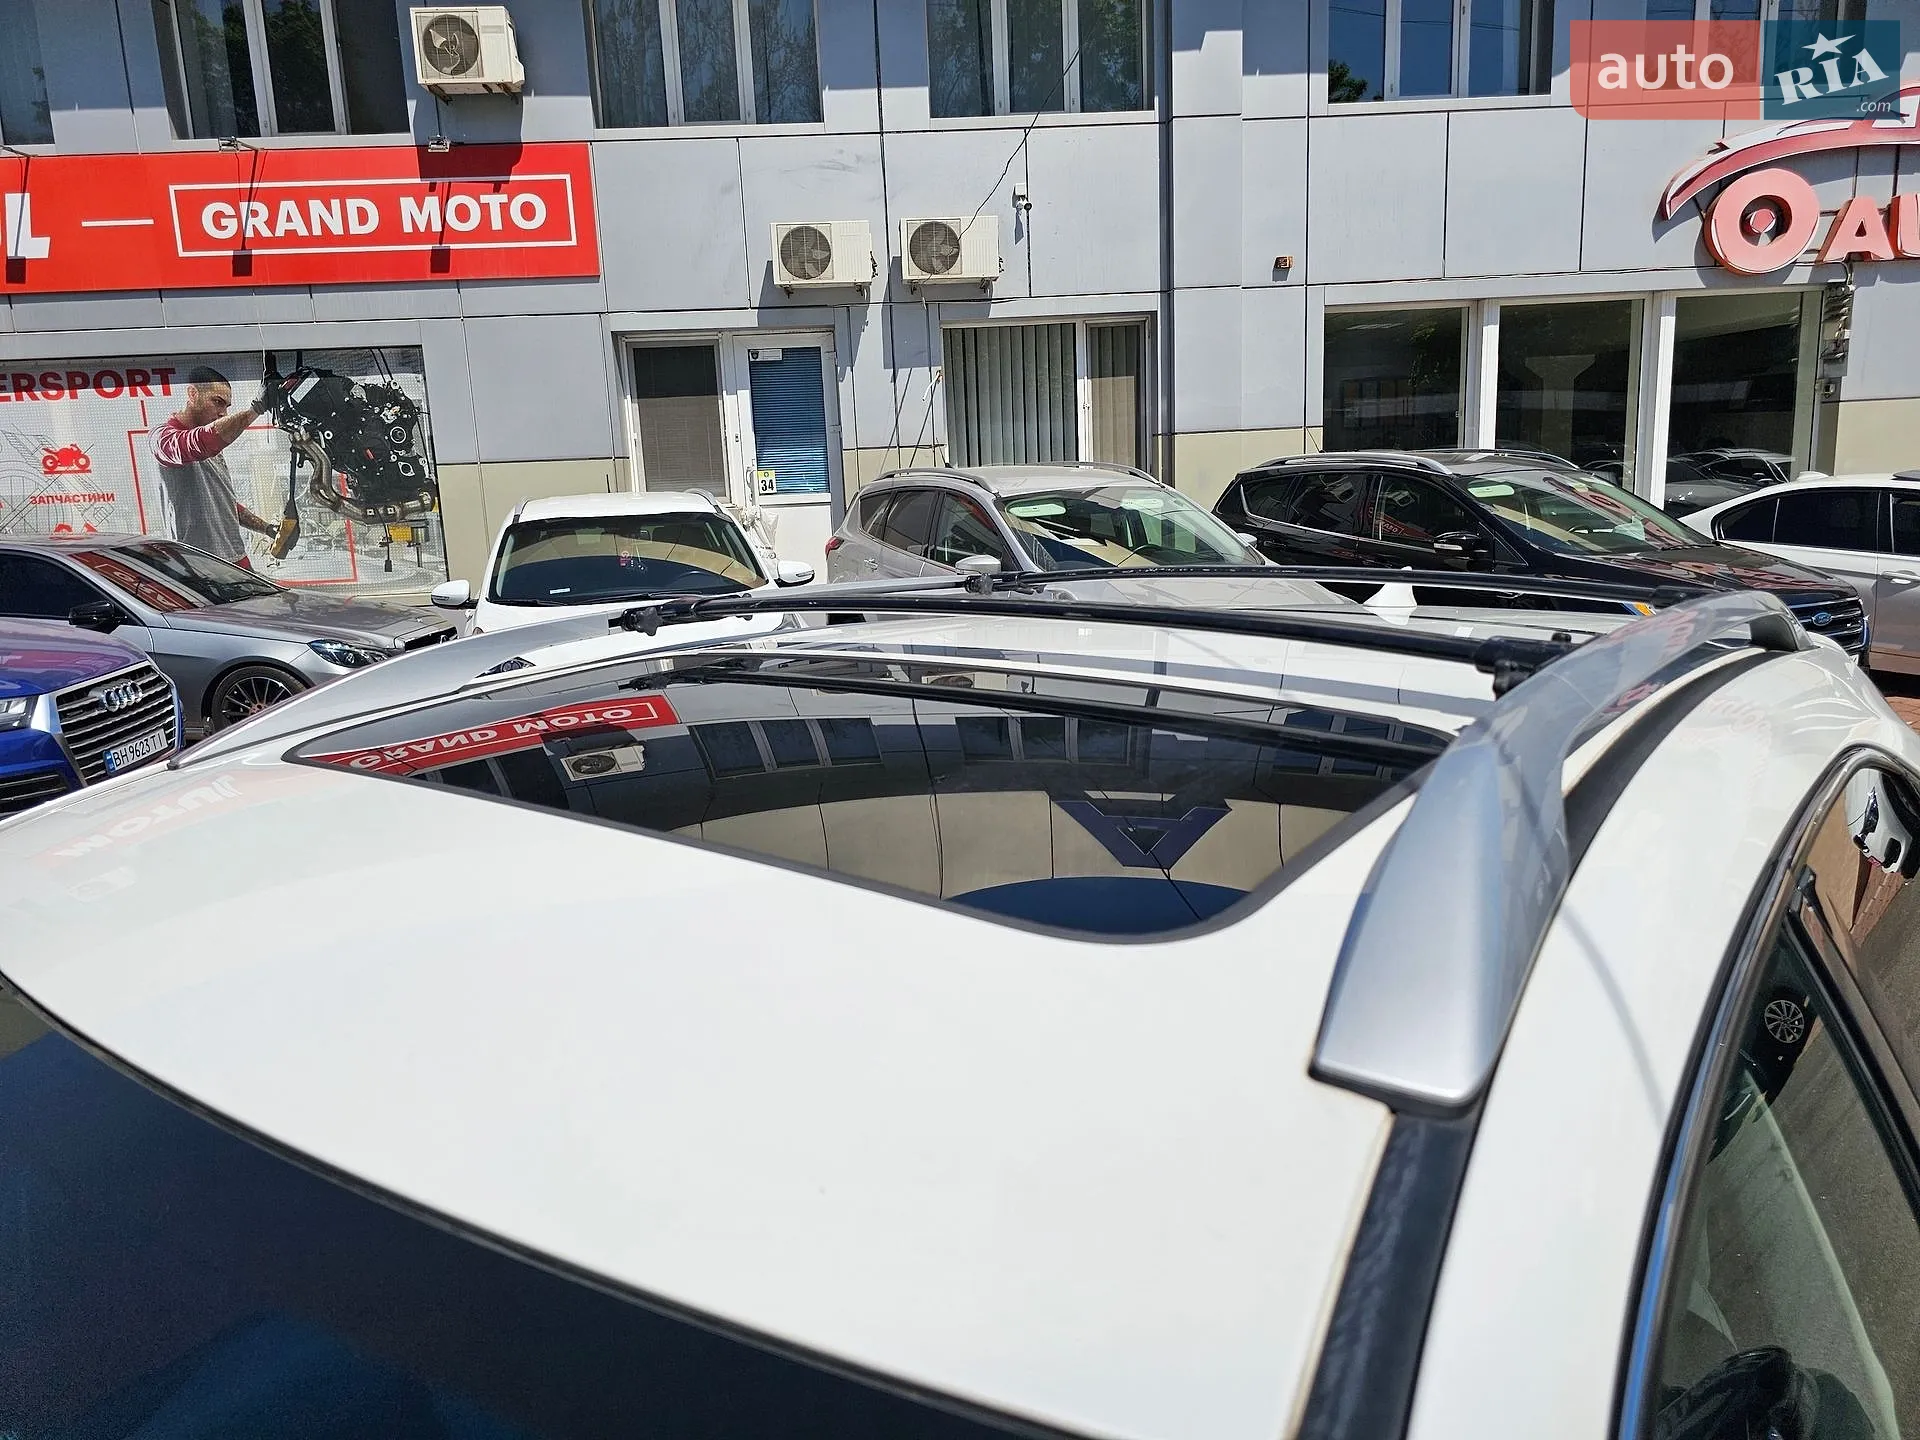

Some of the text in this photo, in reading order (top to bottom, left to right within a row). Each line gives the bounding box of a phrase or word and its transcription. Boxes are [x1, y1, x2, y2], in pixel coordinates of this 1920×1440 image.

[200, 196, 381, 240] GRAND
[401, 192, 548, 234] MOTO
[761, 479, 774, 492] 34
[30, 492, 115, 506] ЗАПЧАСТИНИ
